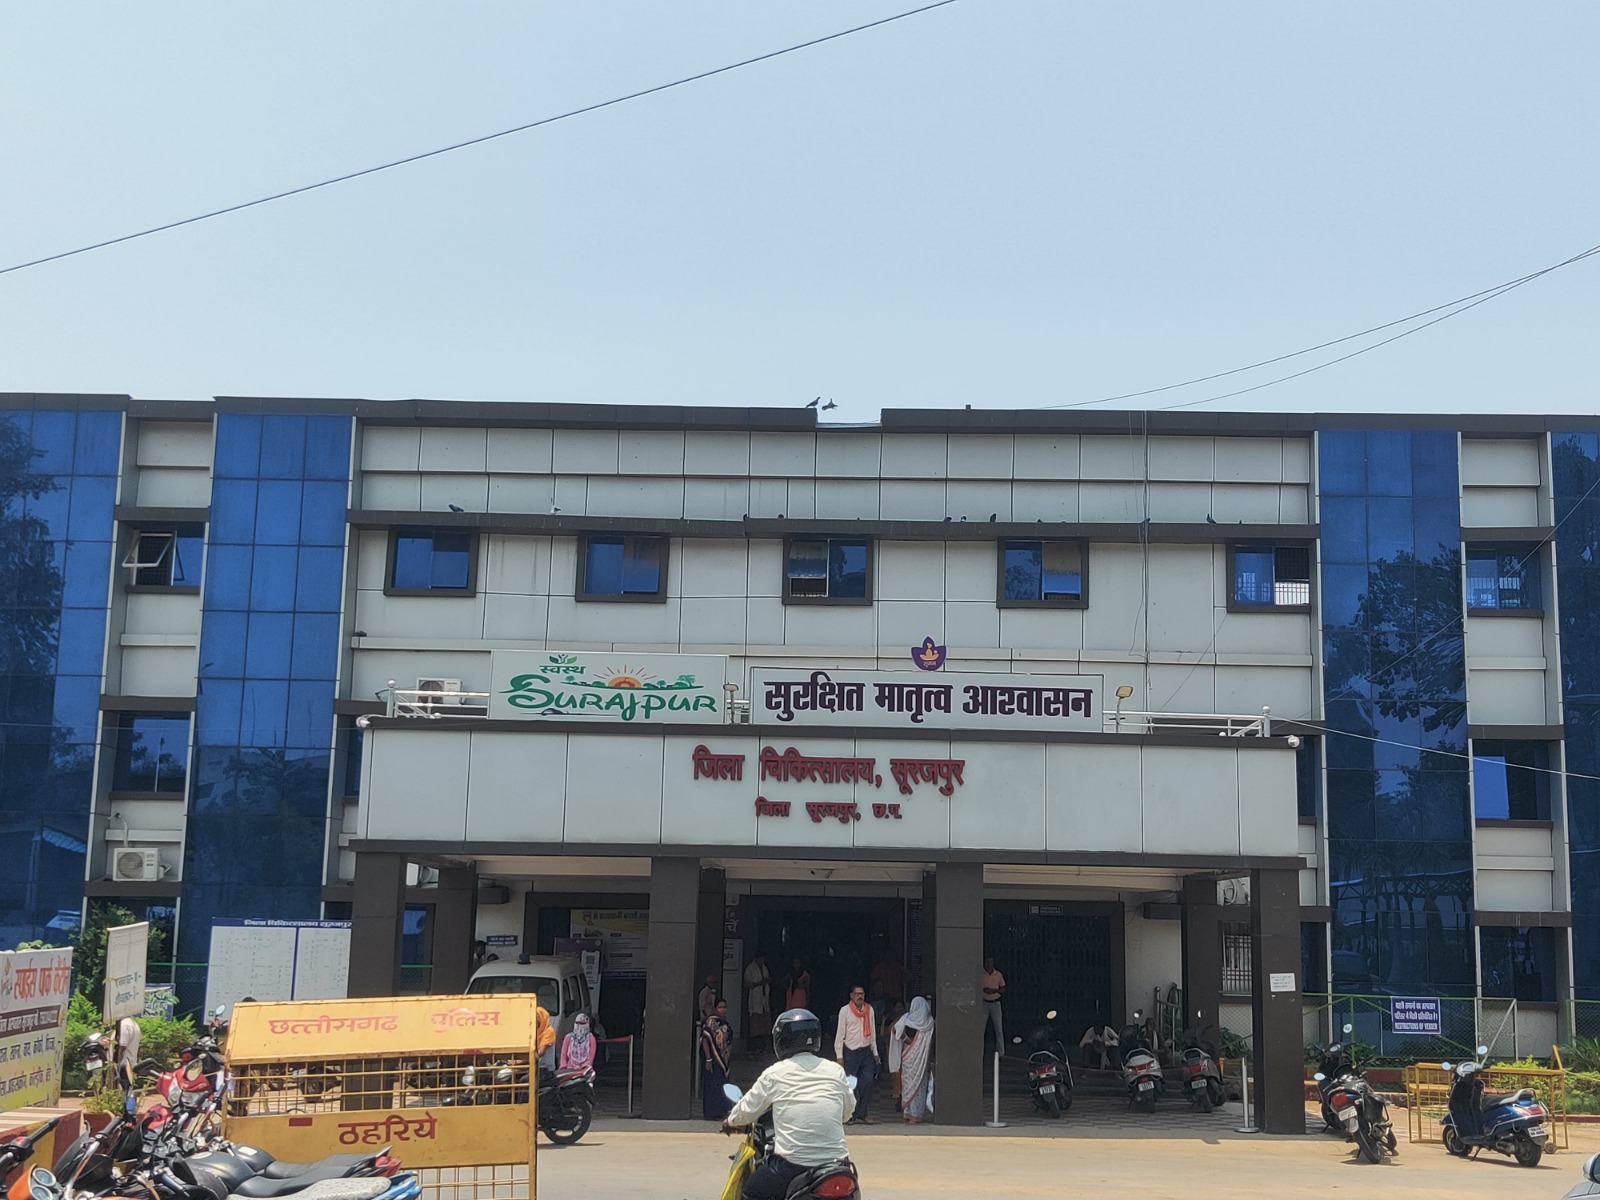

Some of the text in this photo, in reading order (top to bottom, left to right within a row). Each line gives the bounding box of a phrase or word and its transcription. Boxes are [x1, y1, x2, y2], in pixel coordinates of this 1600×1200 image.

[539, 665, 586, 674] स्वस्थ
[763, 671, 1093, 723] सुरक्षित मातृत्व आश्वासन
[692, 744, 966, 796] जिला चिकित्सालय, सूरजपुर
[755, 796, 791, 817] जिला
[805, 802, 861, 824] सूरजपुर,
[431, 1007, 501, 1034] पुलिस
[338, 1111, 438, 1145] ठहरिये
